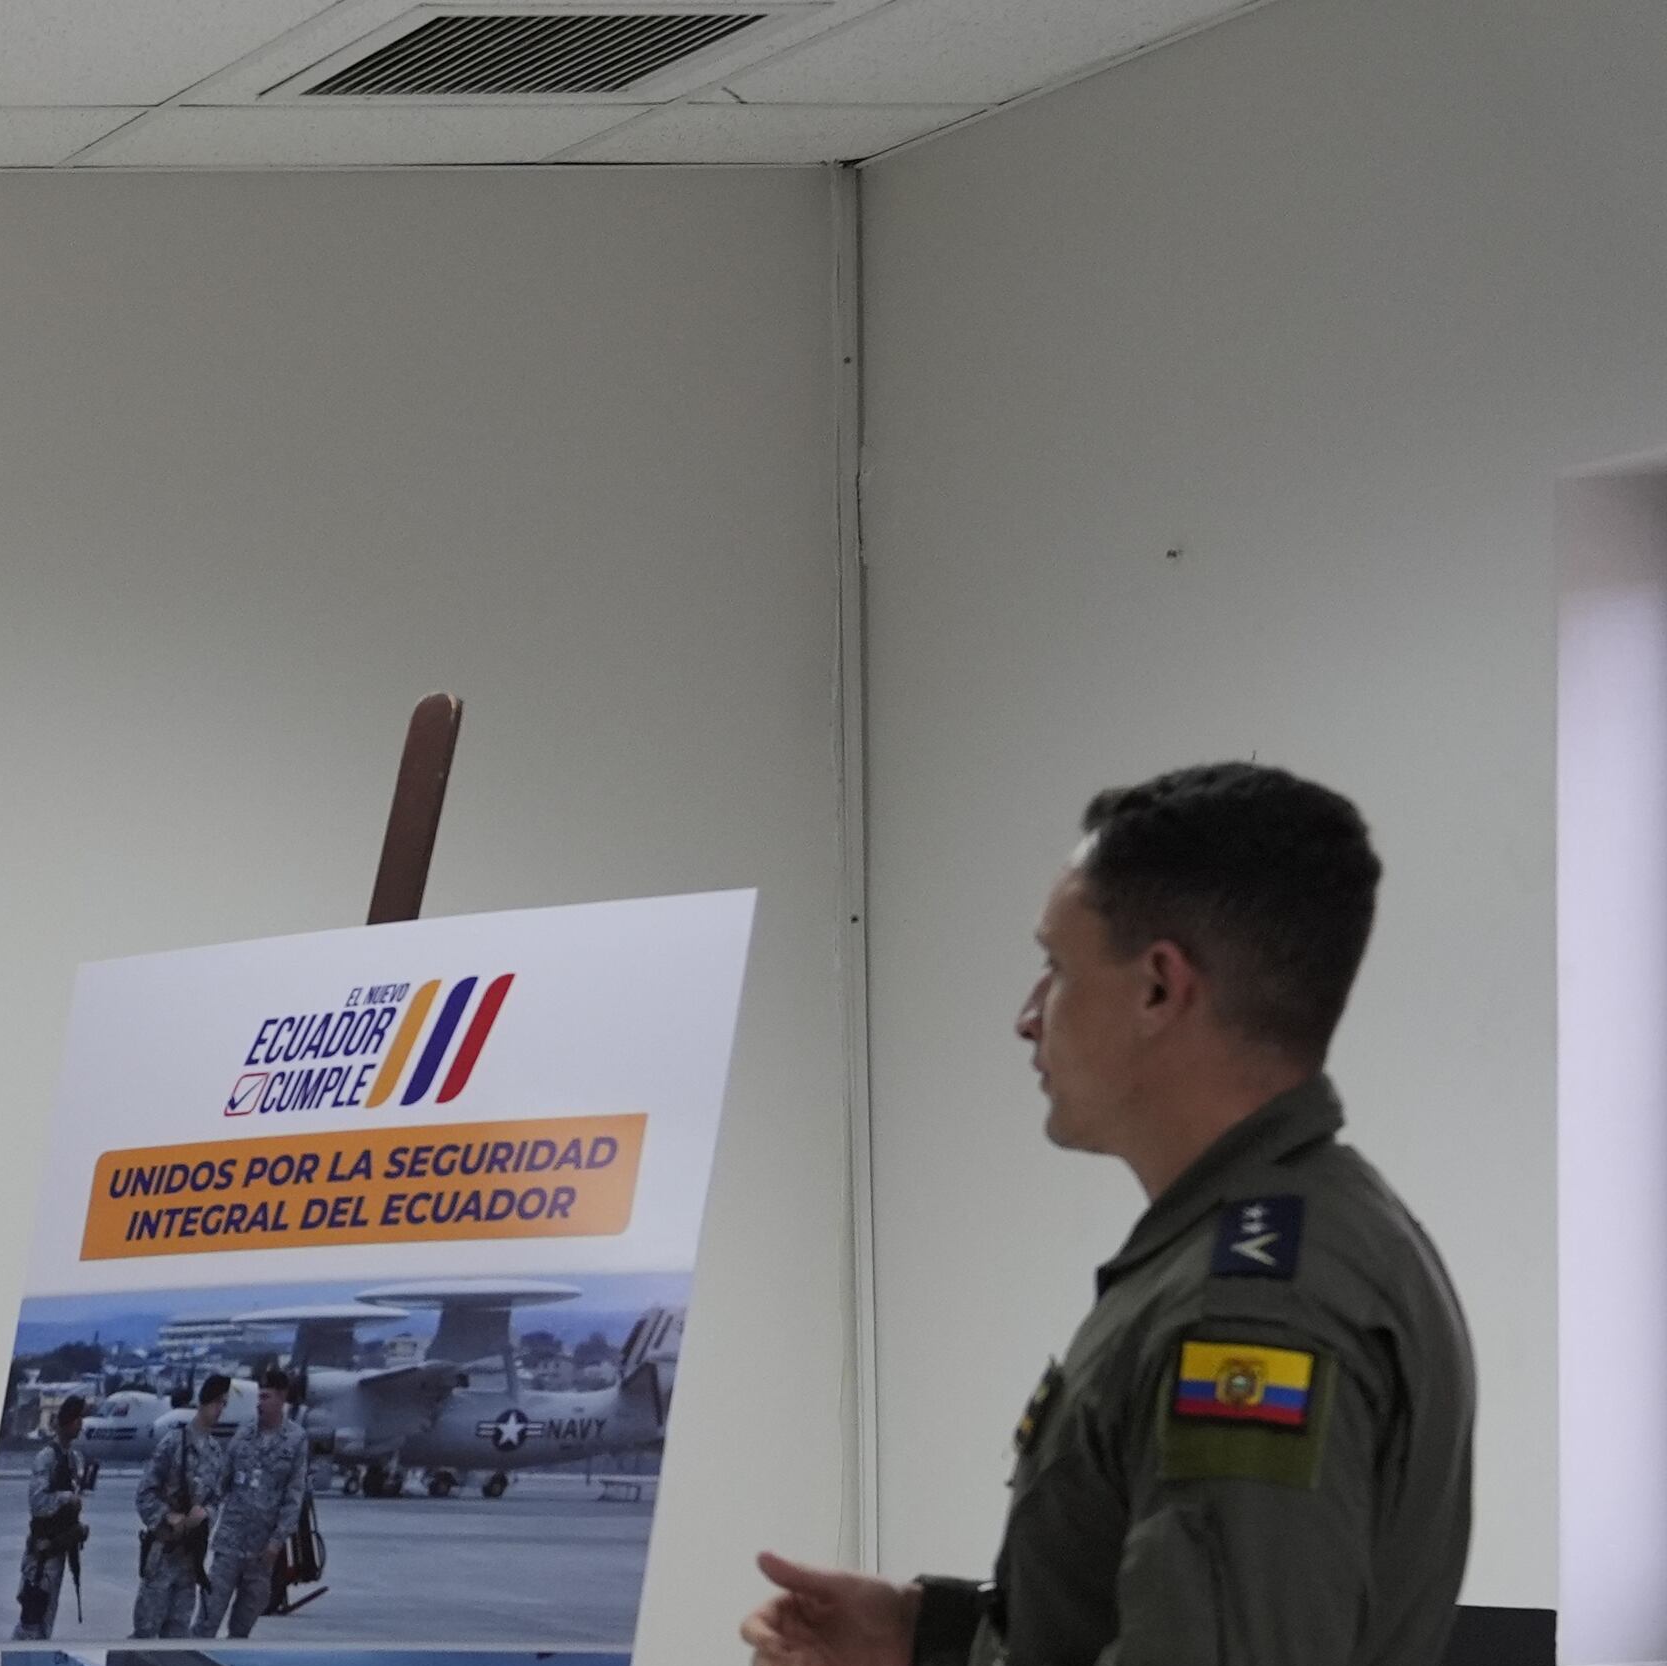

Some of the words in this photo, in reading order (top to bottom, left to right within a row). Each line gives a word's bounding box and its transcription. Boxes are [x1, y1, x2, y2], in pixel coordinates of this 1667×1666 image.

[345, 987, 364, 1008] EL
[364, 982, 411, 1006] NUEVO
[244, 1006, 398, 1066] ECUADOR
[258, 1063, 377, 1114] CUMPLE
[108, 1157, 235, 1199] UNIDOS
[242, 1152, 318, 1190] POR
[326, 1149, 373, 1182] LA
[383, 1136, 619, 1179] SEGURIDAD
[125, 1199, 289, 1242] INTEGRAL
[298, 1195, 369, 1231] DEL
[380, 1186, 577, 1227] ECUADOR
[548, 1418, 607, 1439] NAVY
